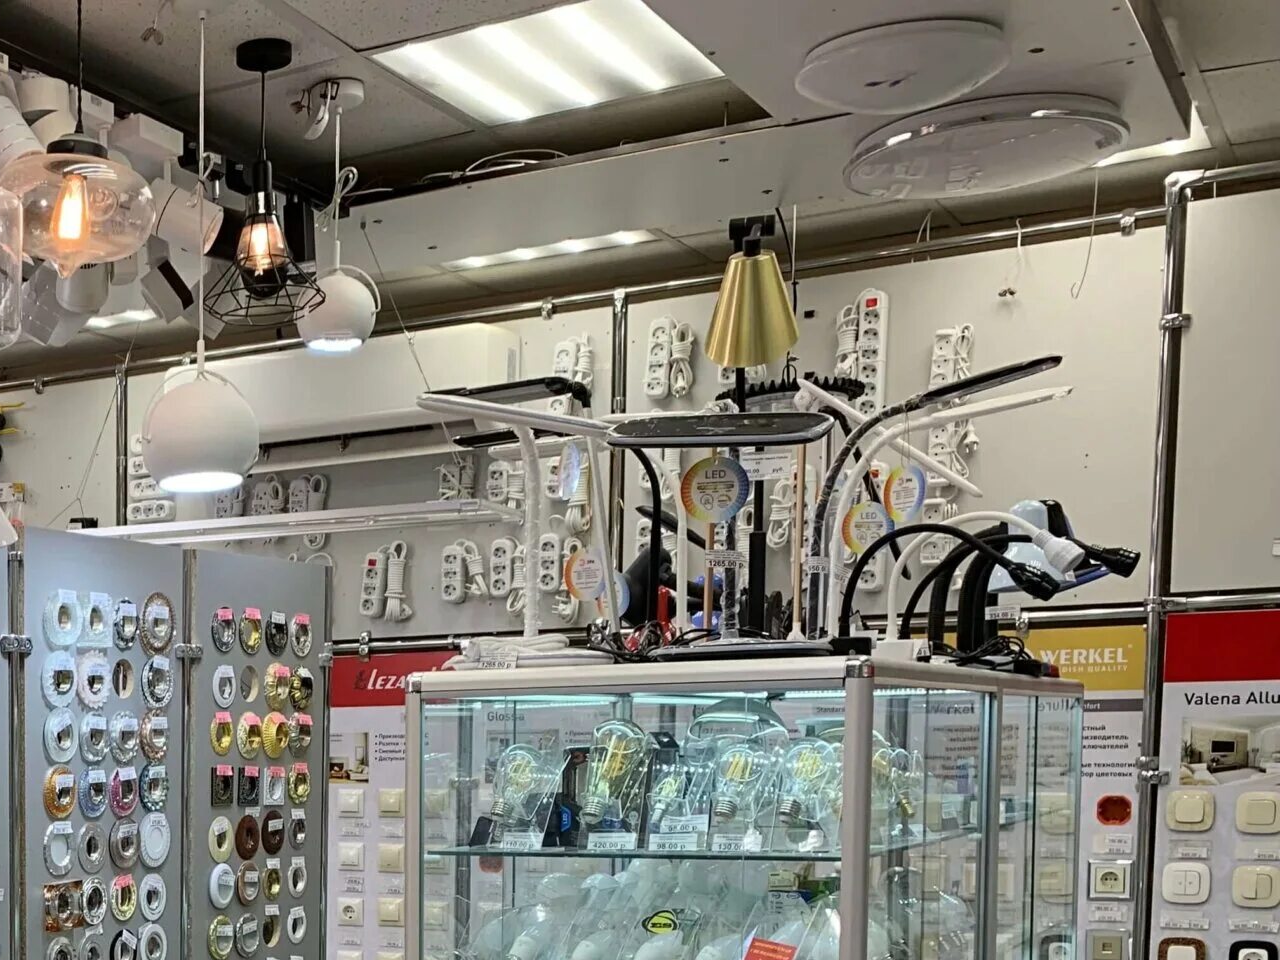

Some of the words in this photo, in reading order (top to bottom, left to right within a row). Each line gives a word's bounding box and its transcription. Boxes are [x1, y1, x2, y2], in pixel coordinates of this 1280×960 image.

[705, 470, 726, 479] LED
[709, 560, 737, 568] 1265.00
[1040, 647, 1128, 664] WERKEL
[1184, 692, 1241, 705] Valena
[1246, 691, 1280, 704] Allu
